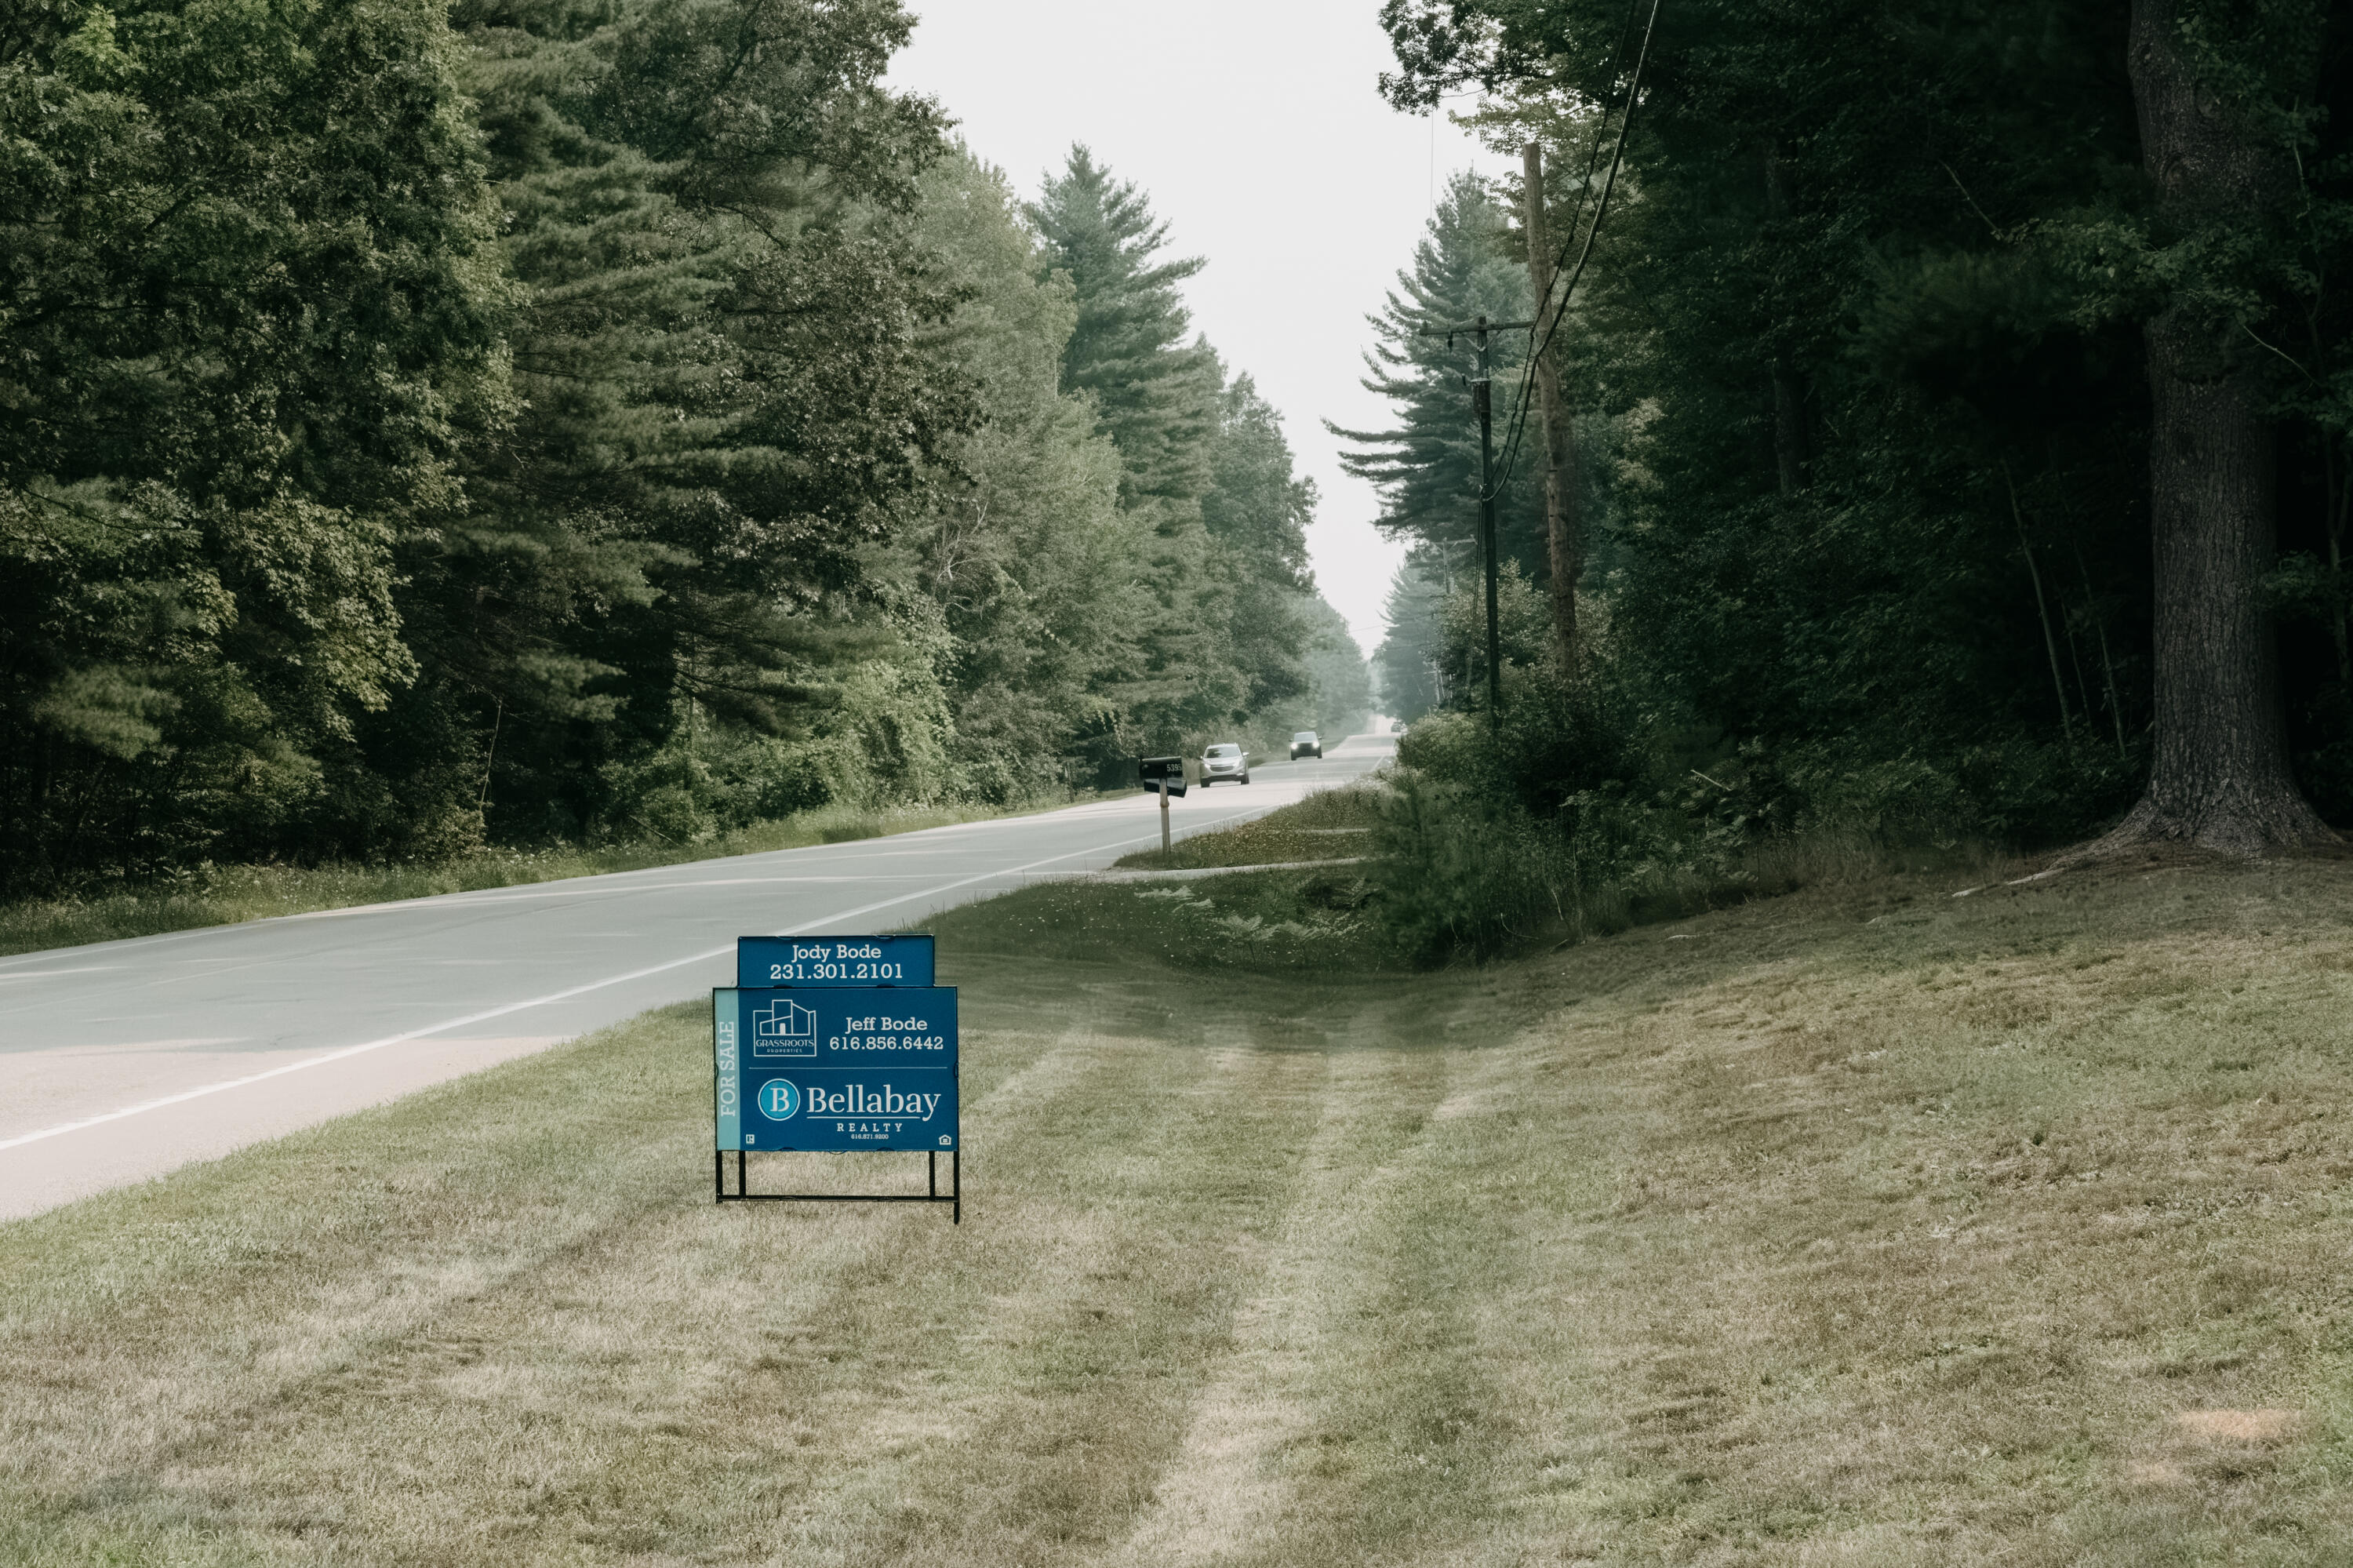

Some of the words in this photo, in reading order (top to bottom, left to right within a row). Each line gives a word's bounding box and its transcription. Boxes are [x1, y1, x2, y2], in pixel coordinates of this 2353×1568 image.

[791, 944, 831, 962] Jody
[836, 944, 882, 959] Bode
[770, 963, 903, 980] 231.301.2101
[845, 1017, 877, 1034] Jeff
[881, 1017, 928, 1031] Bode
[719, 1021, 735, 1071] SALE
[829, 1036, 944, 1050] 616.856.6442
[720, 1076, 736, 1117] FOR
[769, 1087, 790, 1112] B
[806, 1084, 941, 1122] Bellabay
[836, 1122, 903, 1132] REALTY
